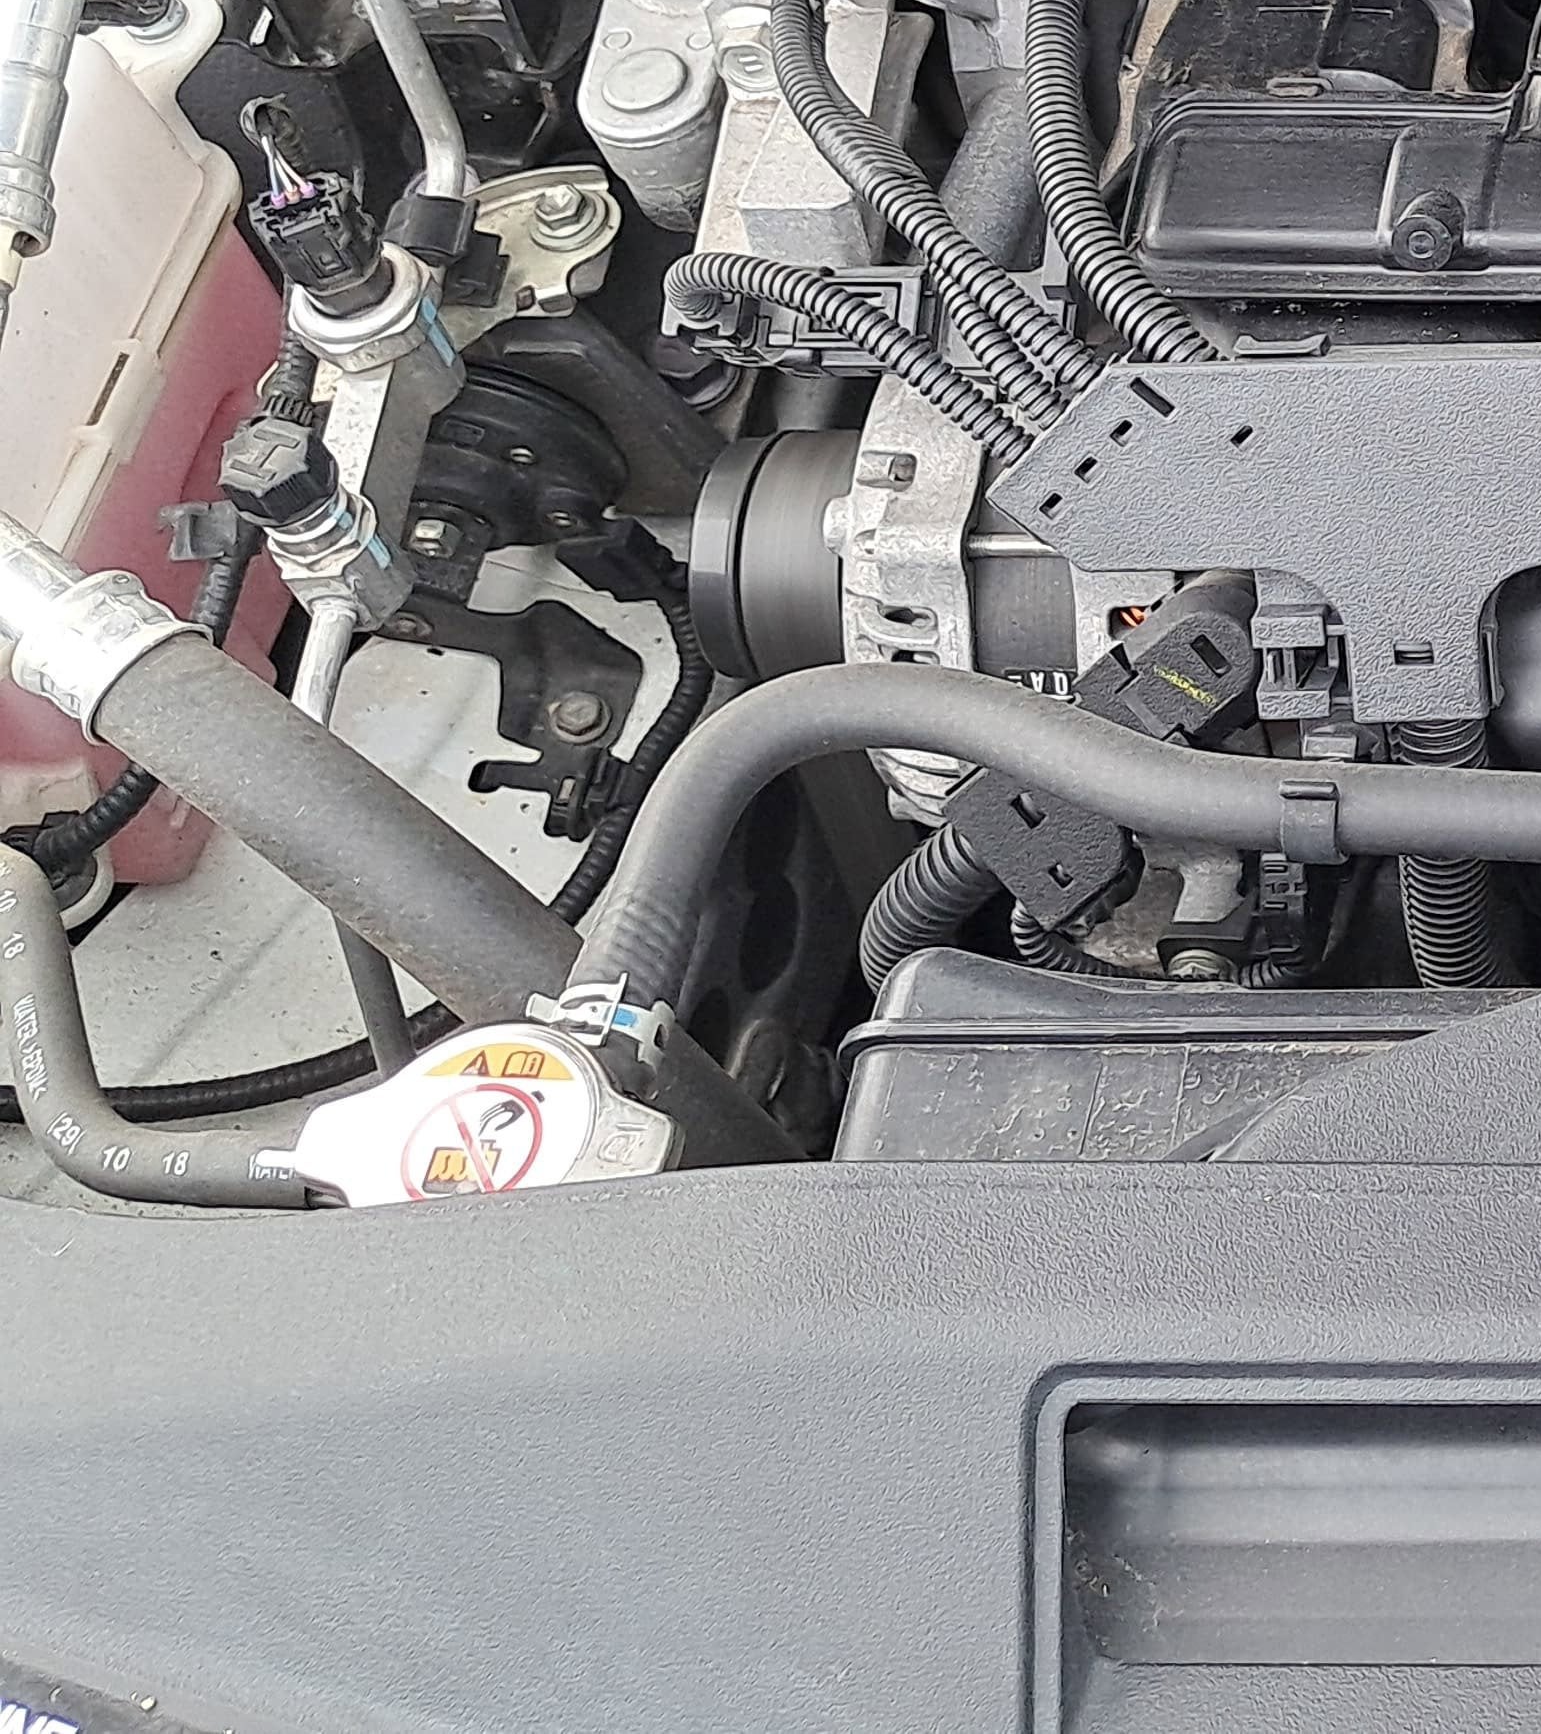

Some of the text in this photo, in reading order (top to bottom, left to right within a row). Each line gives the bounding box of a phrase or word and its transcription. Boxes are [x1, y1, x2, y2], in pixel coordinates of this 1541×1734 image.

[3, 932, 25, 960] 18
[13, 994, 37, 1048] WATER
[102, 1145, 132, 1171] 10
[161, 1150, 190, 1176] 18
